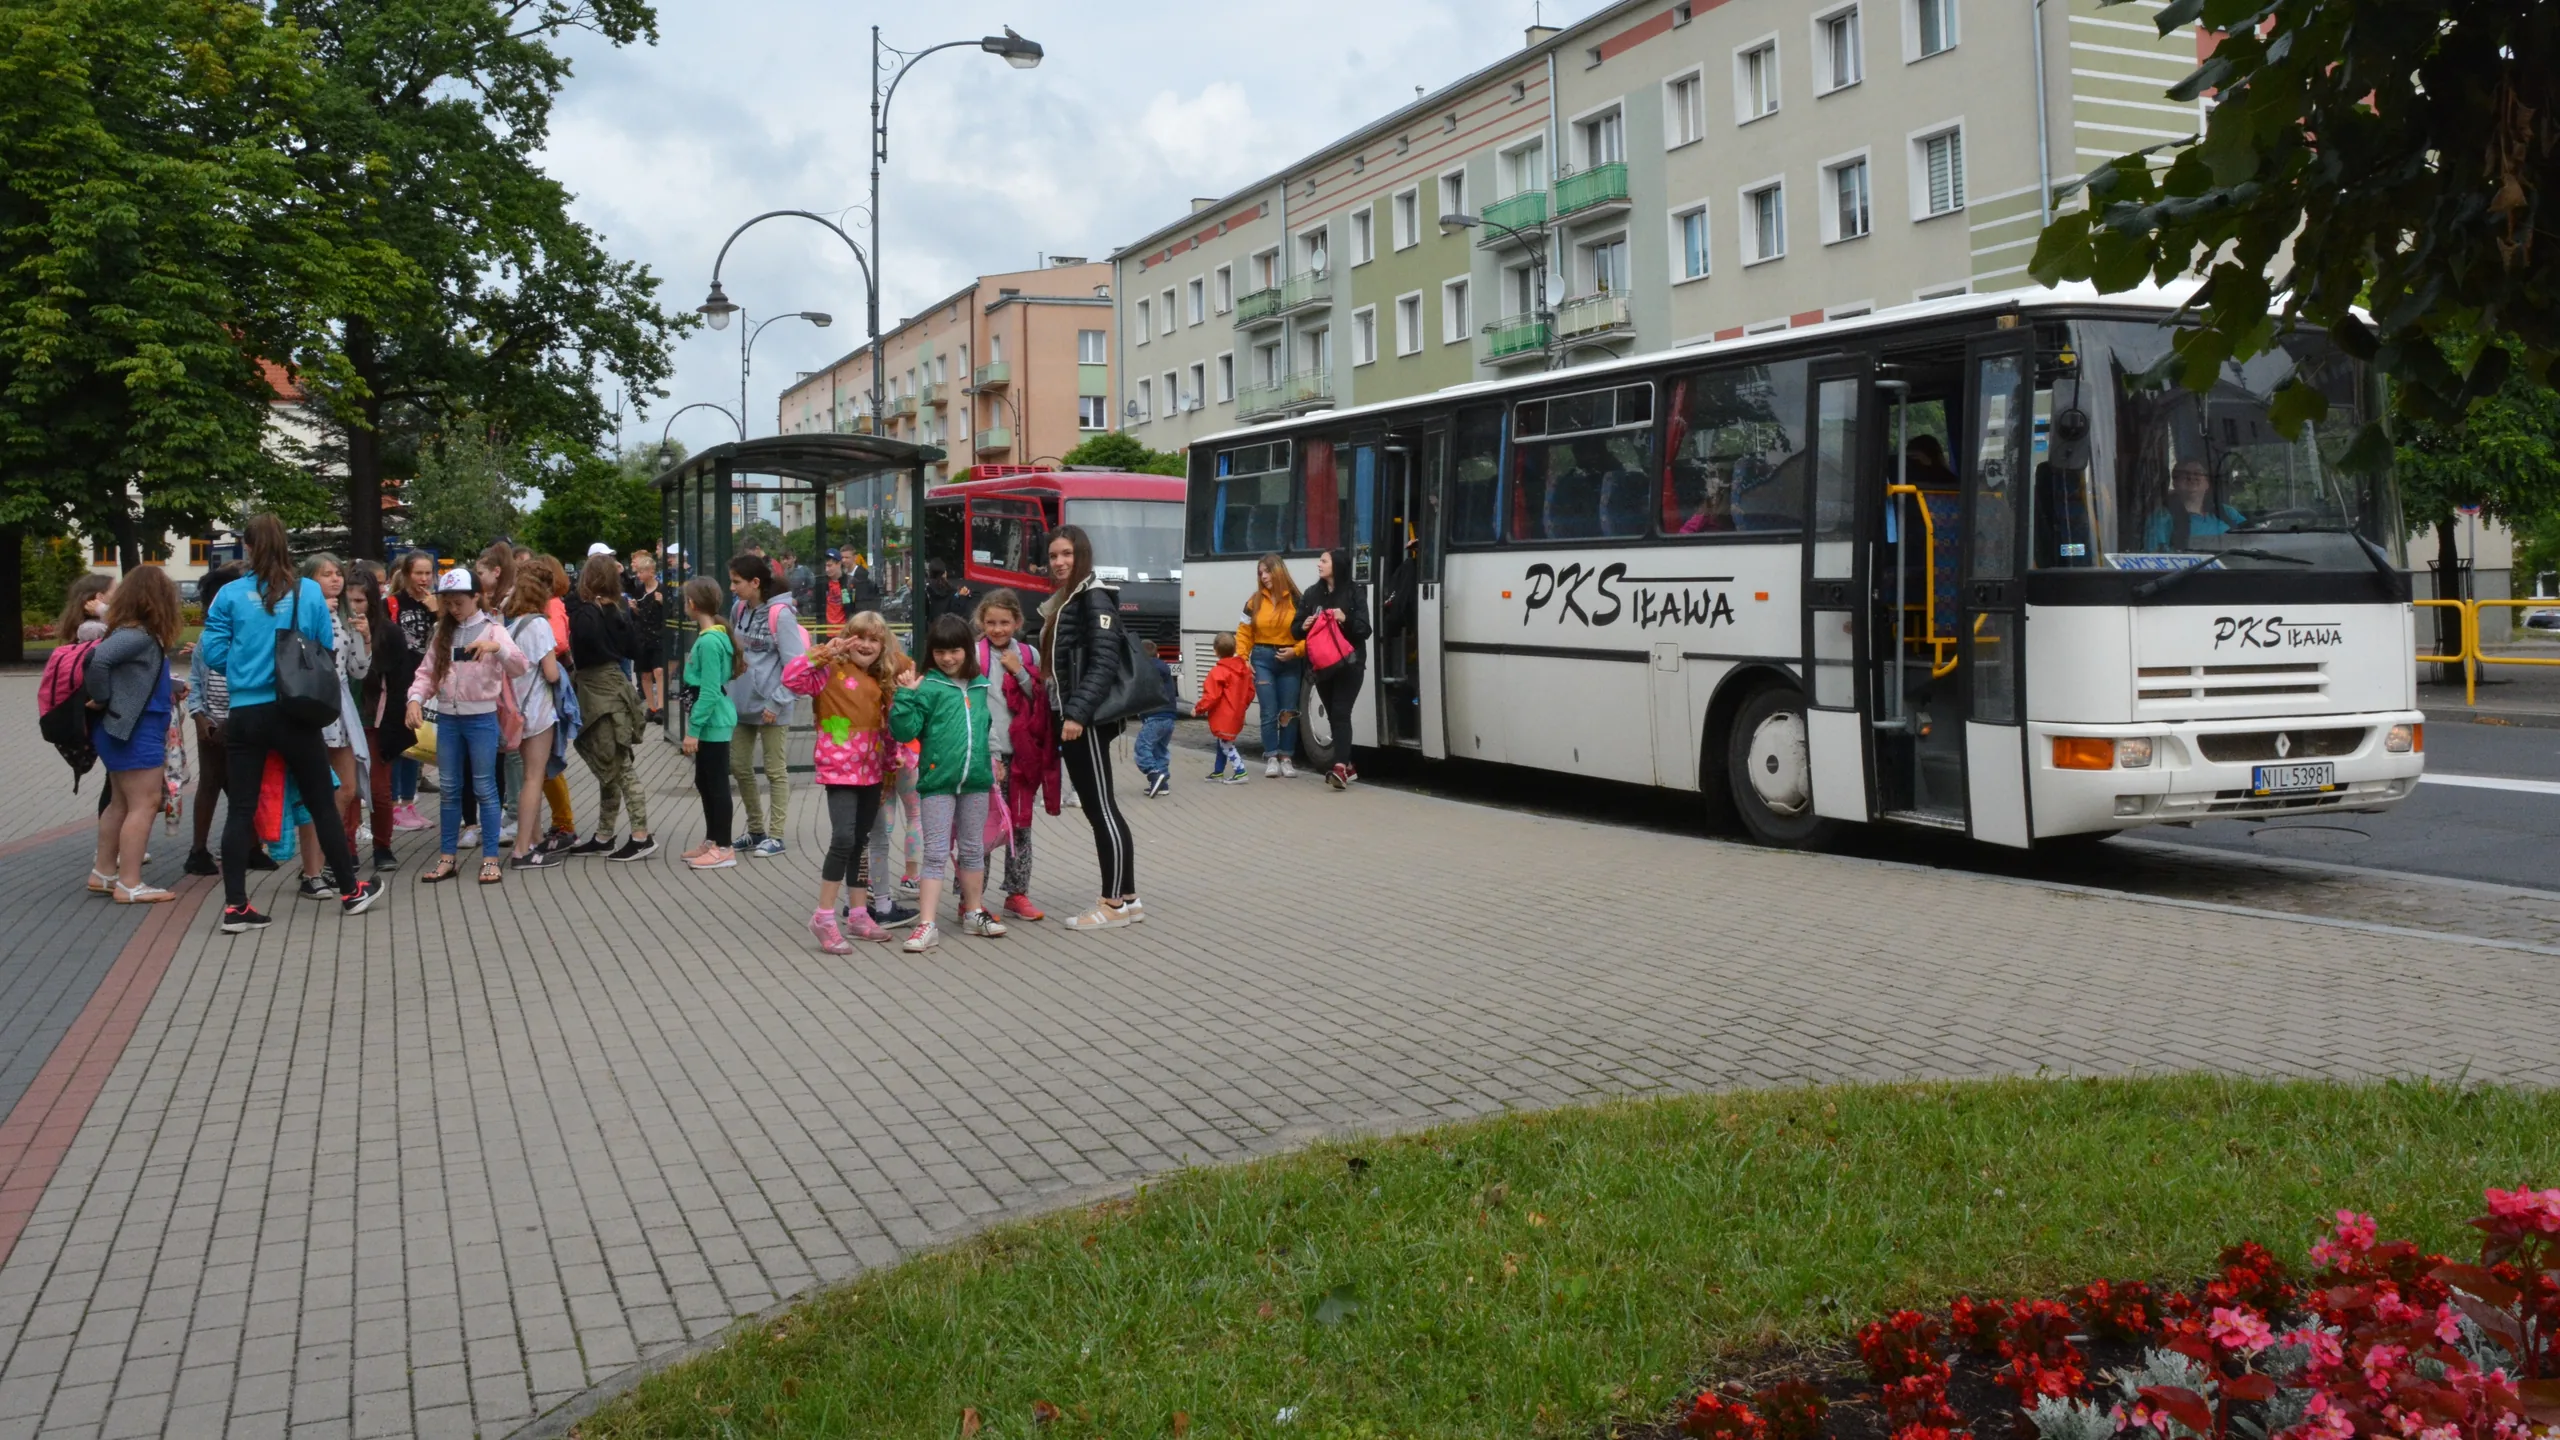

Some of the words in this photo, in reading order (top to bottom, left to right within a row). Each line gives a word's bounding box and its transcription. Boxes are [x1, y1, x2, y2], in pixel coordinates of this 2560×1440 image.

[1523, 562, 1627, 627] PKS
[1632, 587, 1735, 630] IŁAWA
[2214, 616, 2284, 650] PKS
[2288, 629, 2343, 647] IŁAWA
[2261, 769, 2288, 788] NIL
[2292, 766, 2330, 786] 53981
